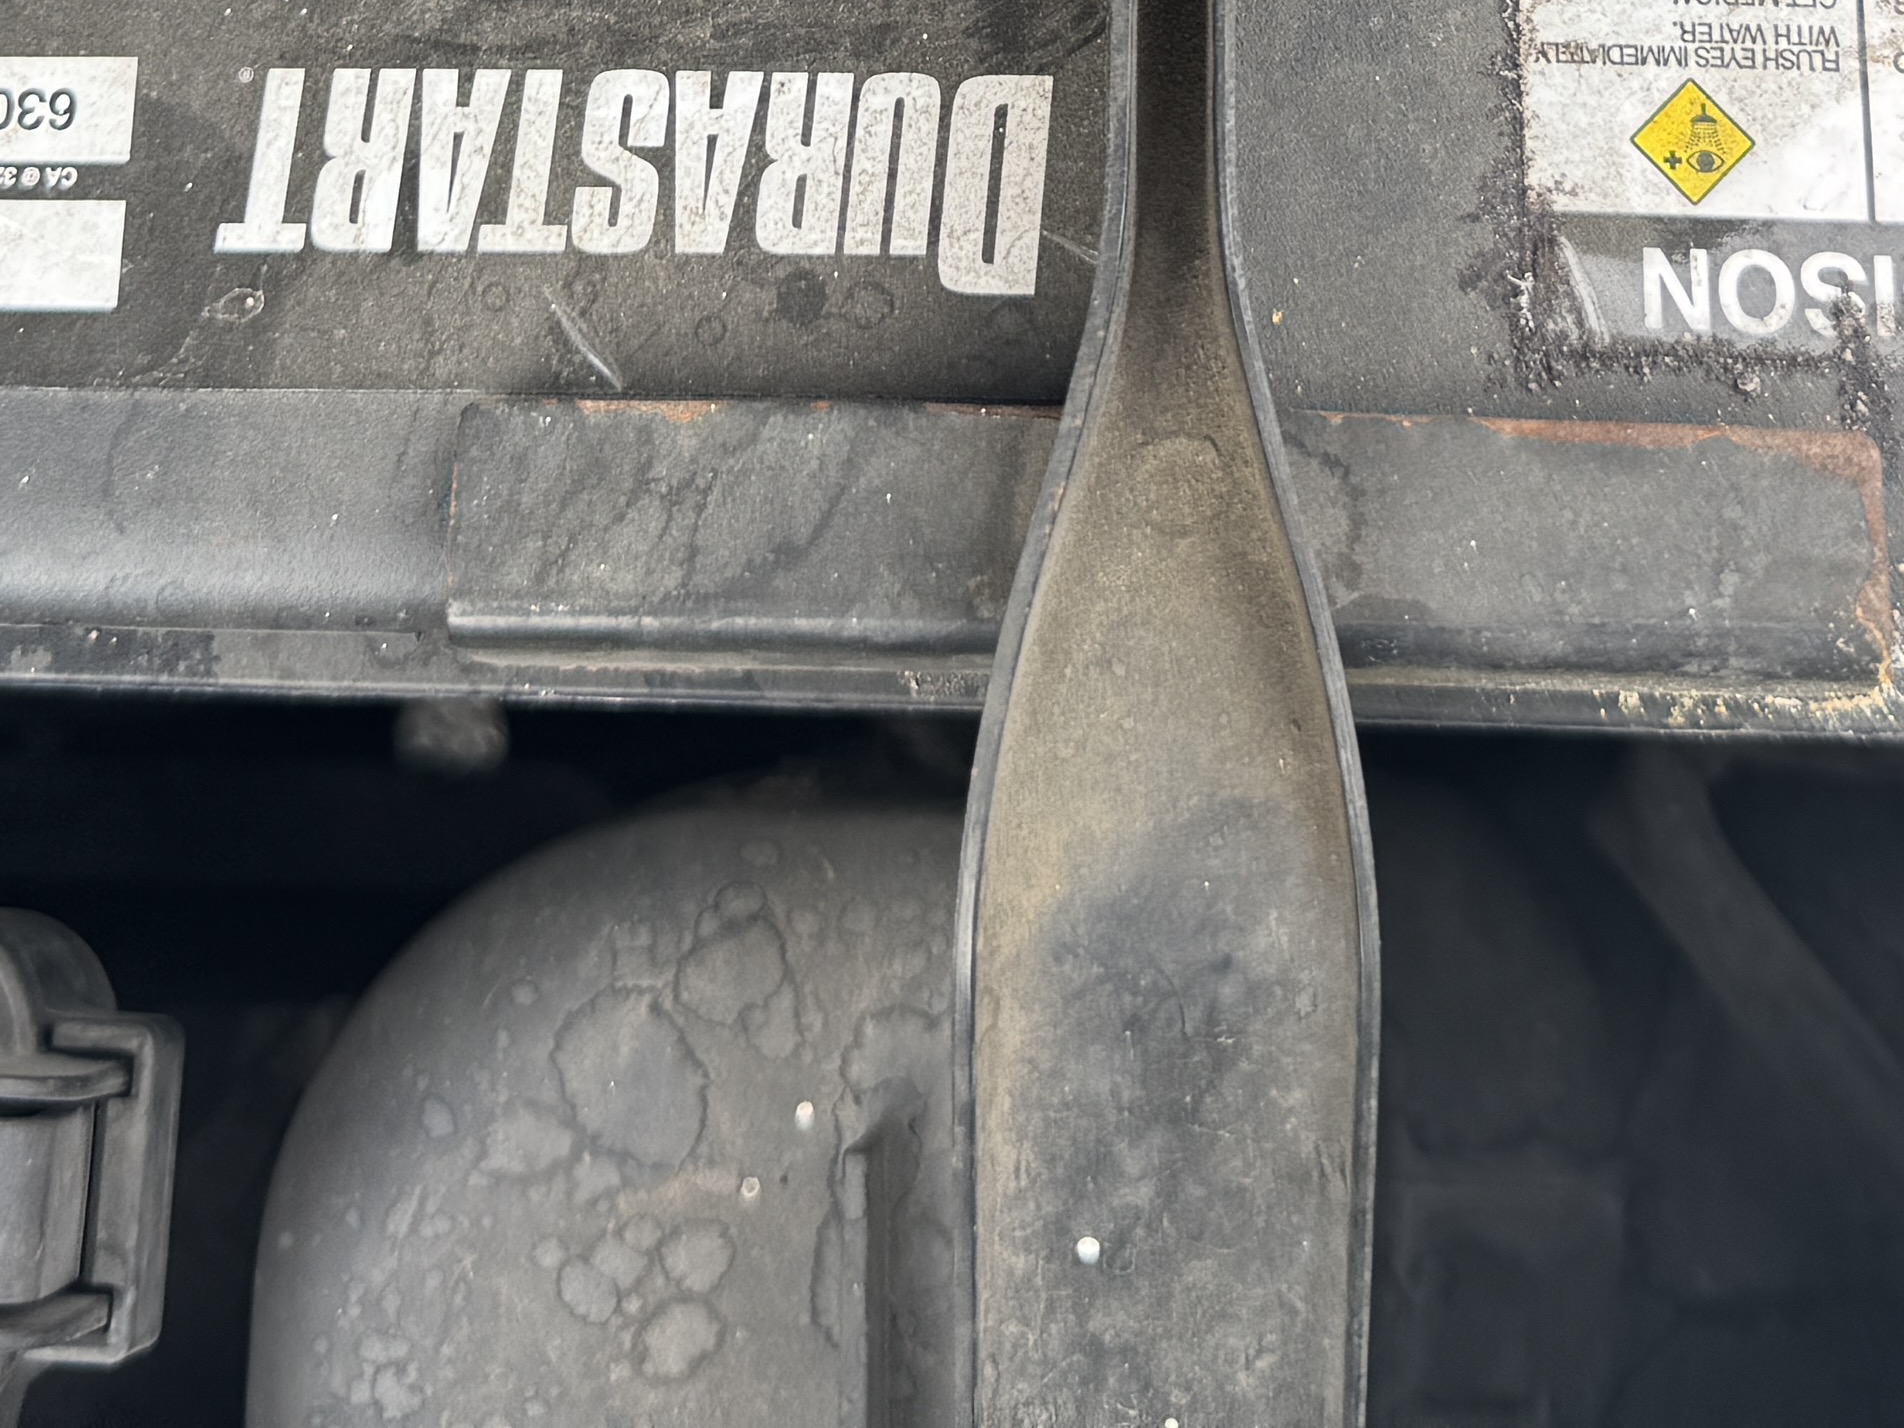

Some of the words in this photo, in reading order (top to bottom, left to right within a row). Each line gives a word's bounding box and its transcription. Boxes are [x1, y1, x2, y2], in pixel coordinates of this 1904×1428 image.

[1672, 20, 1767, 45] WATER.
[1773, 23, 1839, 47] WITH
[1534, 41, 1689, 67] IMMEDIATELY
[1694, 45, 1757, 69] EYES
[1762, 47, 1841, 72] FLUSH
[46, 167, 78, 187] CA
